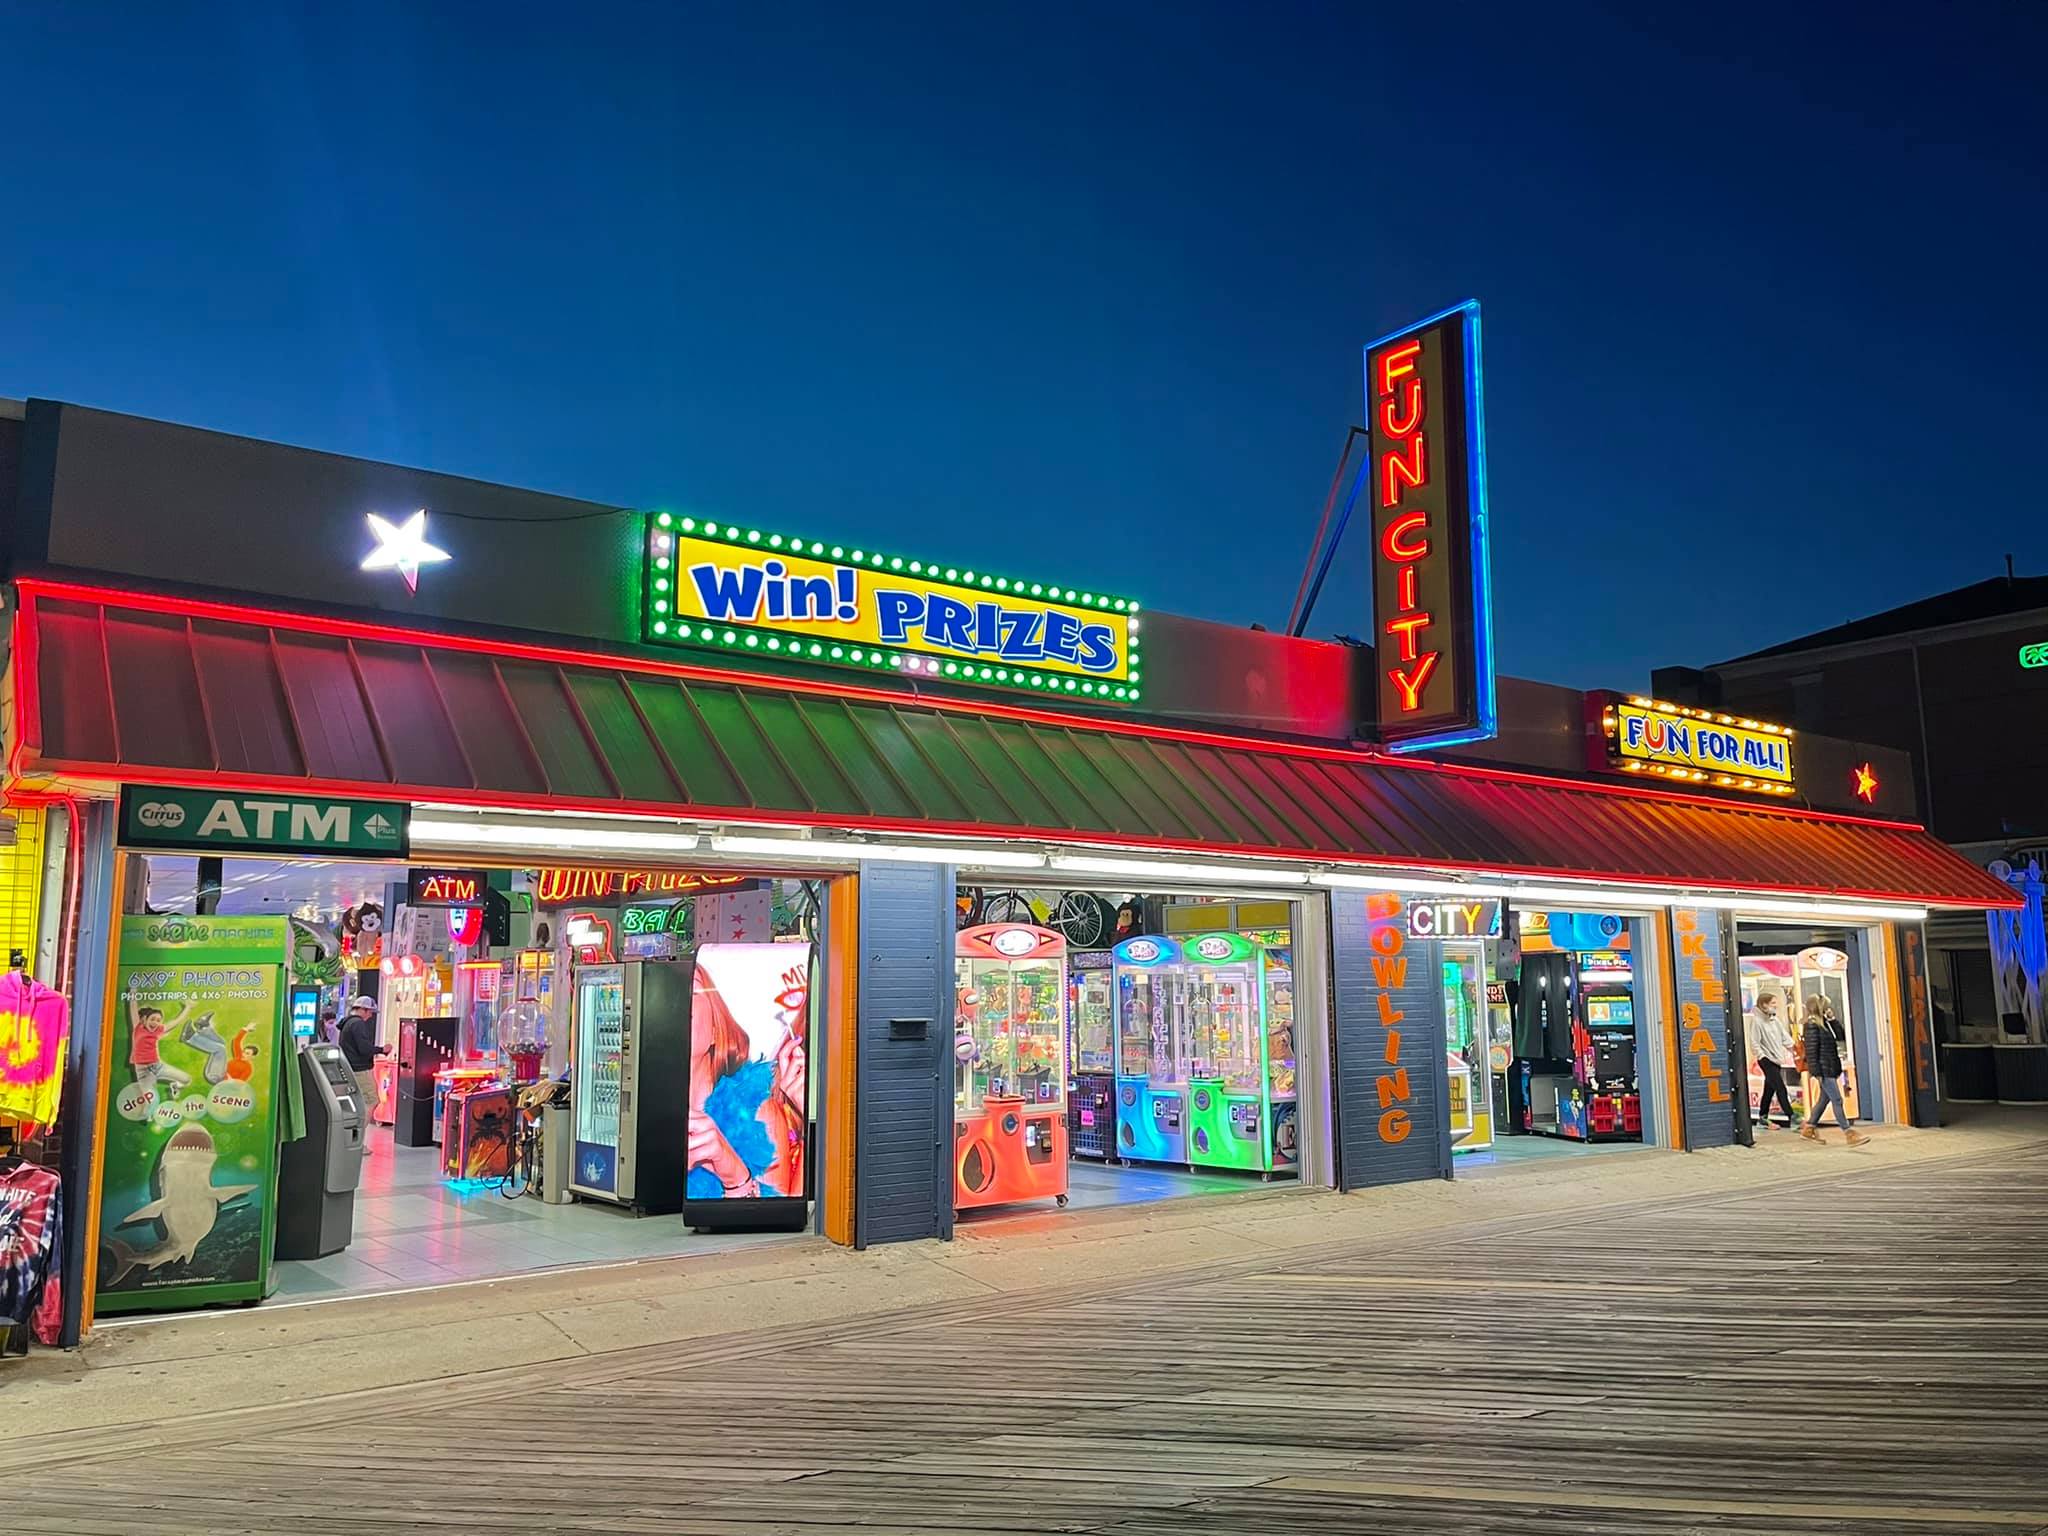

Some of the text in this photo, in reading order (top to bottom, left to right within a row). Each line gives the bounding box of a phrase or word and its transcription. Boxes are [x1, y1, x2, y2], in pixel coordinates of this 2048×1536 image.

[1377, 339, 1440, 712] FUN CITY
[687, 559, 1118, 673] Win! PRIZES
[1626, 715, 1785, 774] FUN FOR ALL!
[141, 806, 183, 823] Cirrus
[196, 800, 351, 842] ATM
[423, 876, 475, 899] ATM
[147, 923, 210, 943] scene
[1412, 903, 1482, 935] CITY
[121, 991, 188, 1001] PHOTOSTRIPS
[228, 989, 269, 999] PHOTOS
[182, 970, 264, 988] PHOTOS
[1367, 892, 1413, 1144] BOWLING
[1676, 910, 1730, 1104] SKEE BALL
[1906, 930, 1928, 1091] PINBALL
[123, 1091, 154, 1112] drop
[185, 1101, 205, 1112] the
